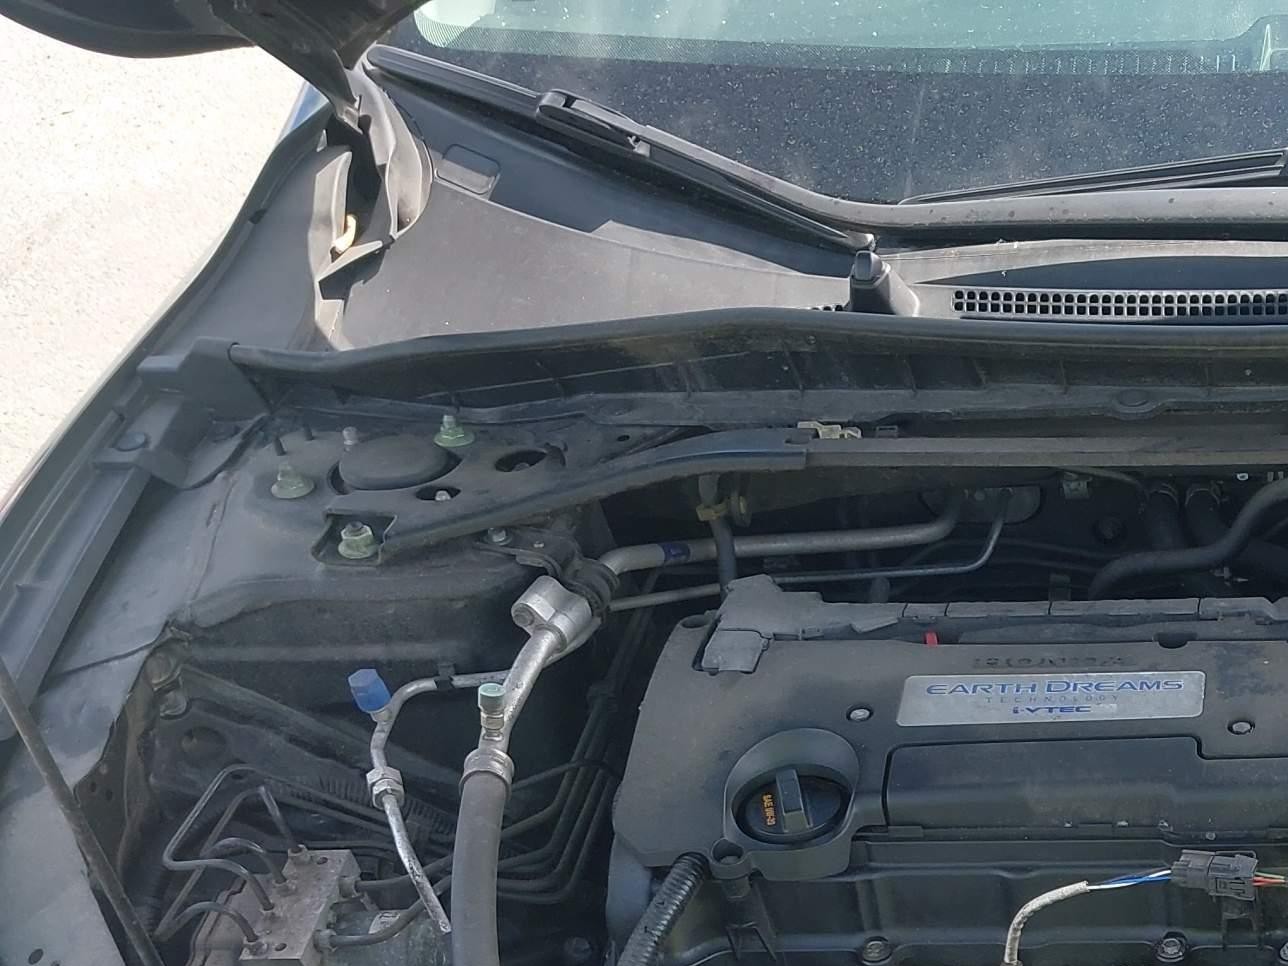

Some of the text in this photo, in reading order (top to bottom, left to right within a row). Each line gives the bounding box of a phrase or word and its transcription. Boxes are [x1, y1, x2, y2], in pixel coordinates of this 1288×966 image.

[926, 679, 1184, 695] EARTH DREAMS
[985, 694, 1119, 703] TECHNOLOGY
[1012, 705, 1092, 714] i-VTEC
